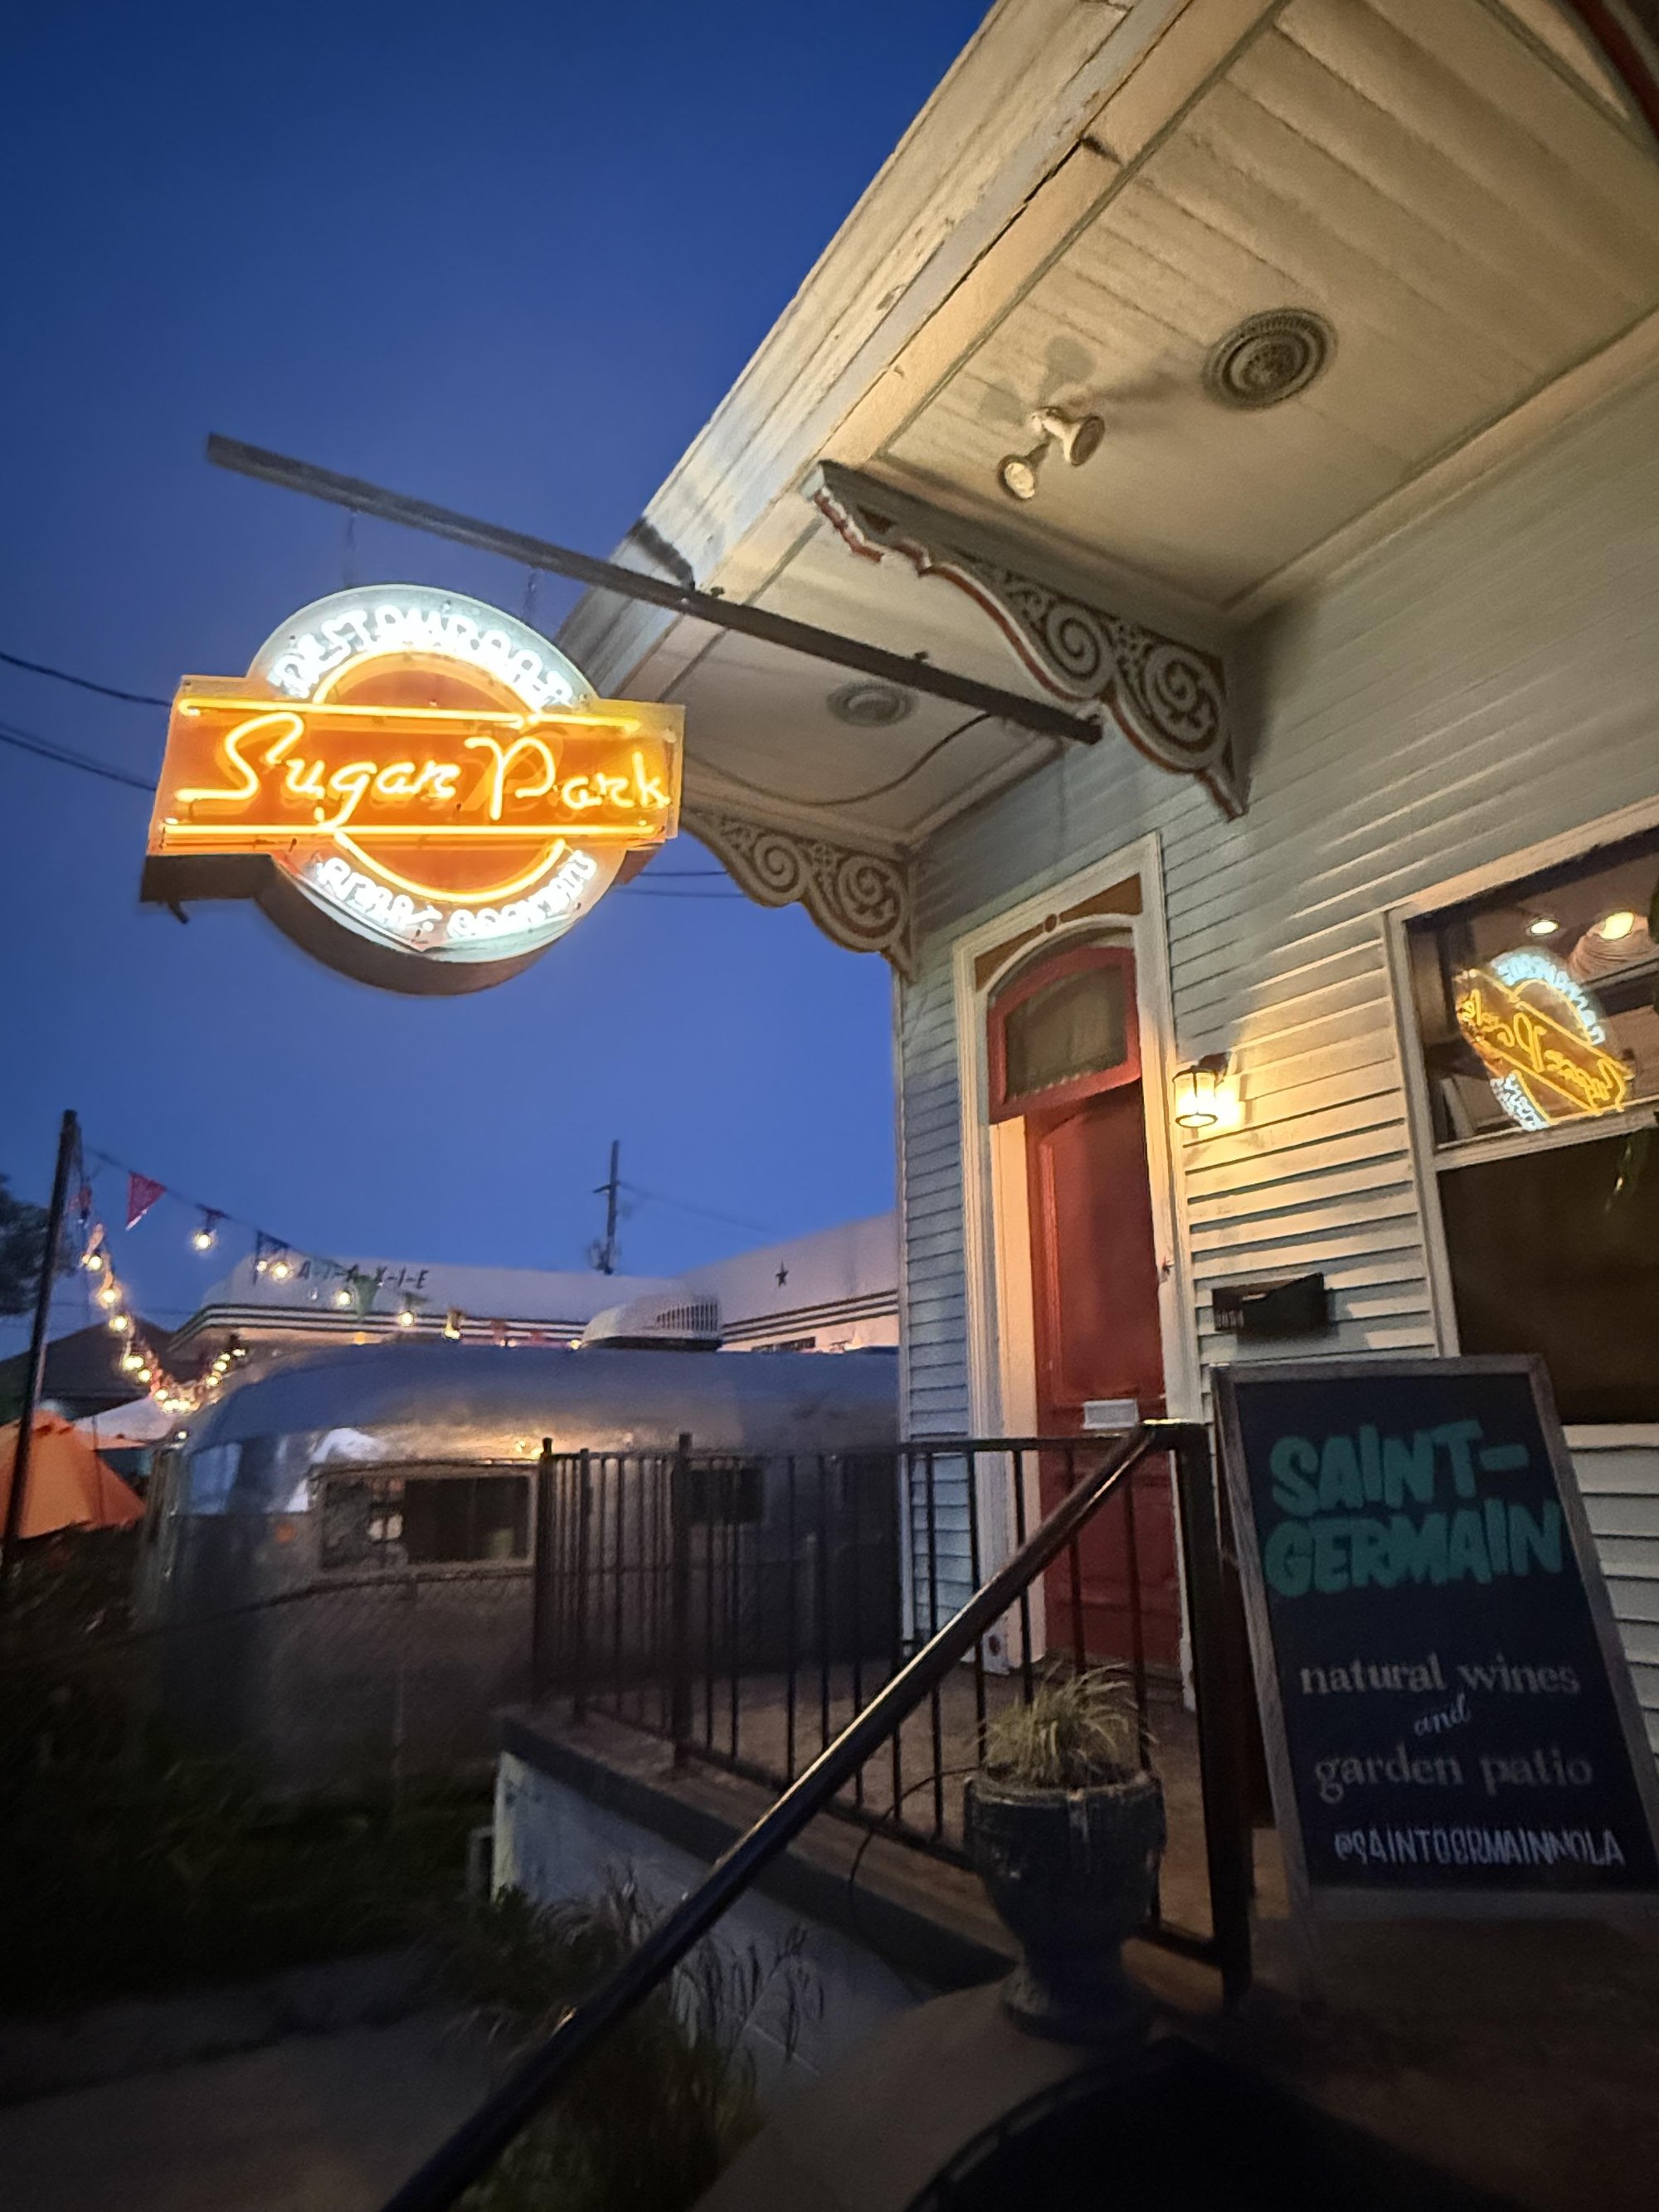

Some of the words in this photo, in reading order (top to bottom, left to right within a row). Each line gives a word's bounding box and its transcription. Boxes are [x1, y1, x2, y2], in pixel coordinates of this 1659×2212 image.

[174, 712, 460, 831] Sugar
[464, 736, 670, 821] Park
[1269, 1418, 1530, 1517] SAINT-
[1263, 1498, 1564, 1597] GERMAIN
[1299, 1653, 1447, 1695] natural
[1457, 1653, 1581, 1695] wines
[1413, 1693, 1472, 1737] and
[1314, 1745, 1464, 1805] garden
[1480, 1747, 1593, 1797] patio
